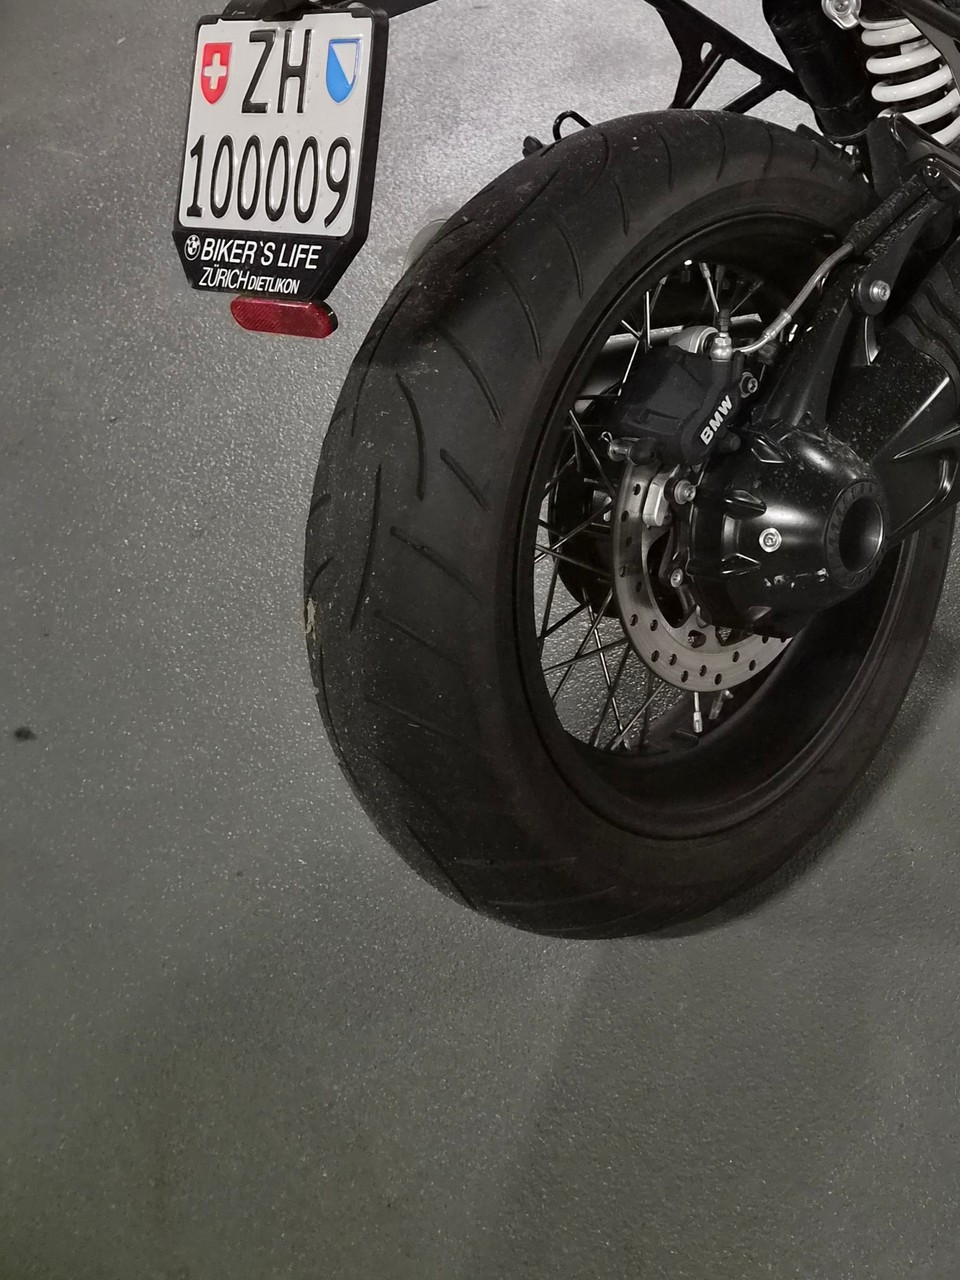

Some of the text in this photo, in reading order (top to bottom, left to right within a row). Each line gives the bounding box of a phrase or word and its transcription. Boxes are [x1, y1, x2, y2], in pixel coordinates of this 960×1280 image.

[241, 28, 314, 114] ZH
[186, 134, 352, 229] 100009
[198, 264, 301, 295] ZÜRICH DIETLIKON
[277, 242, 322, 270] LIFE
[700, 394, 734, 446] BMW
